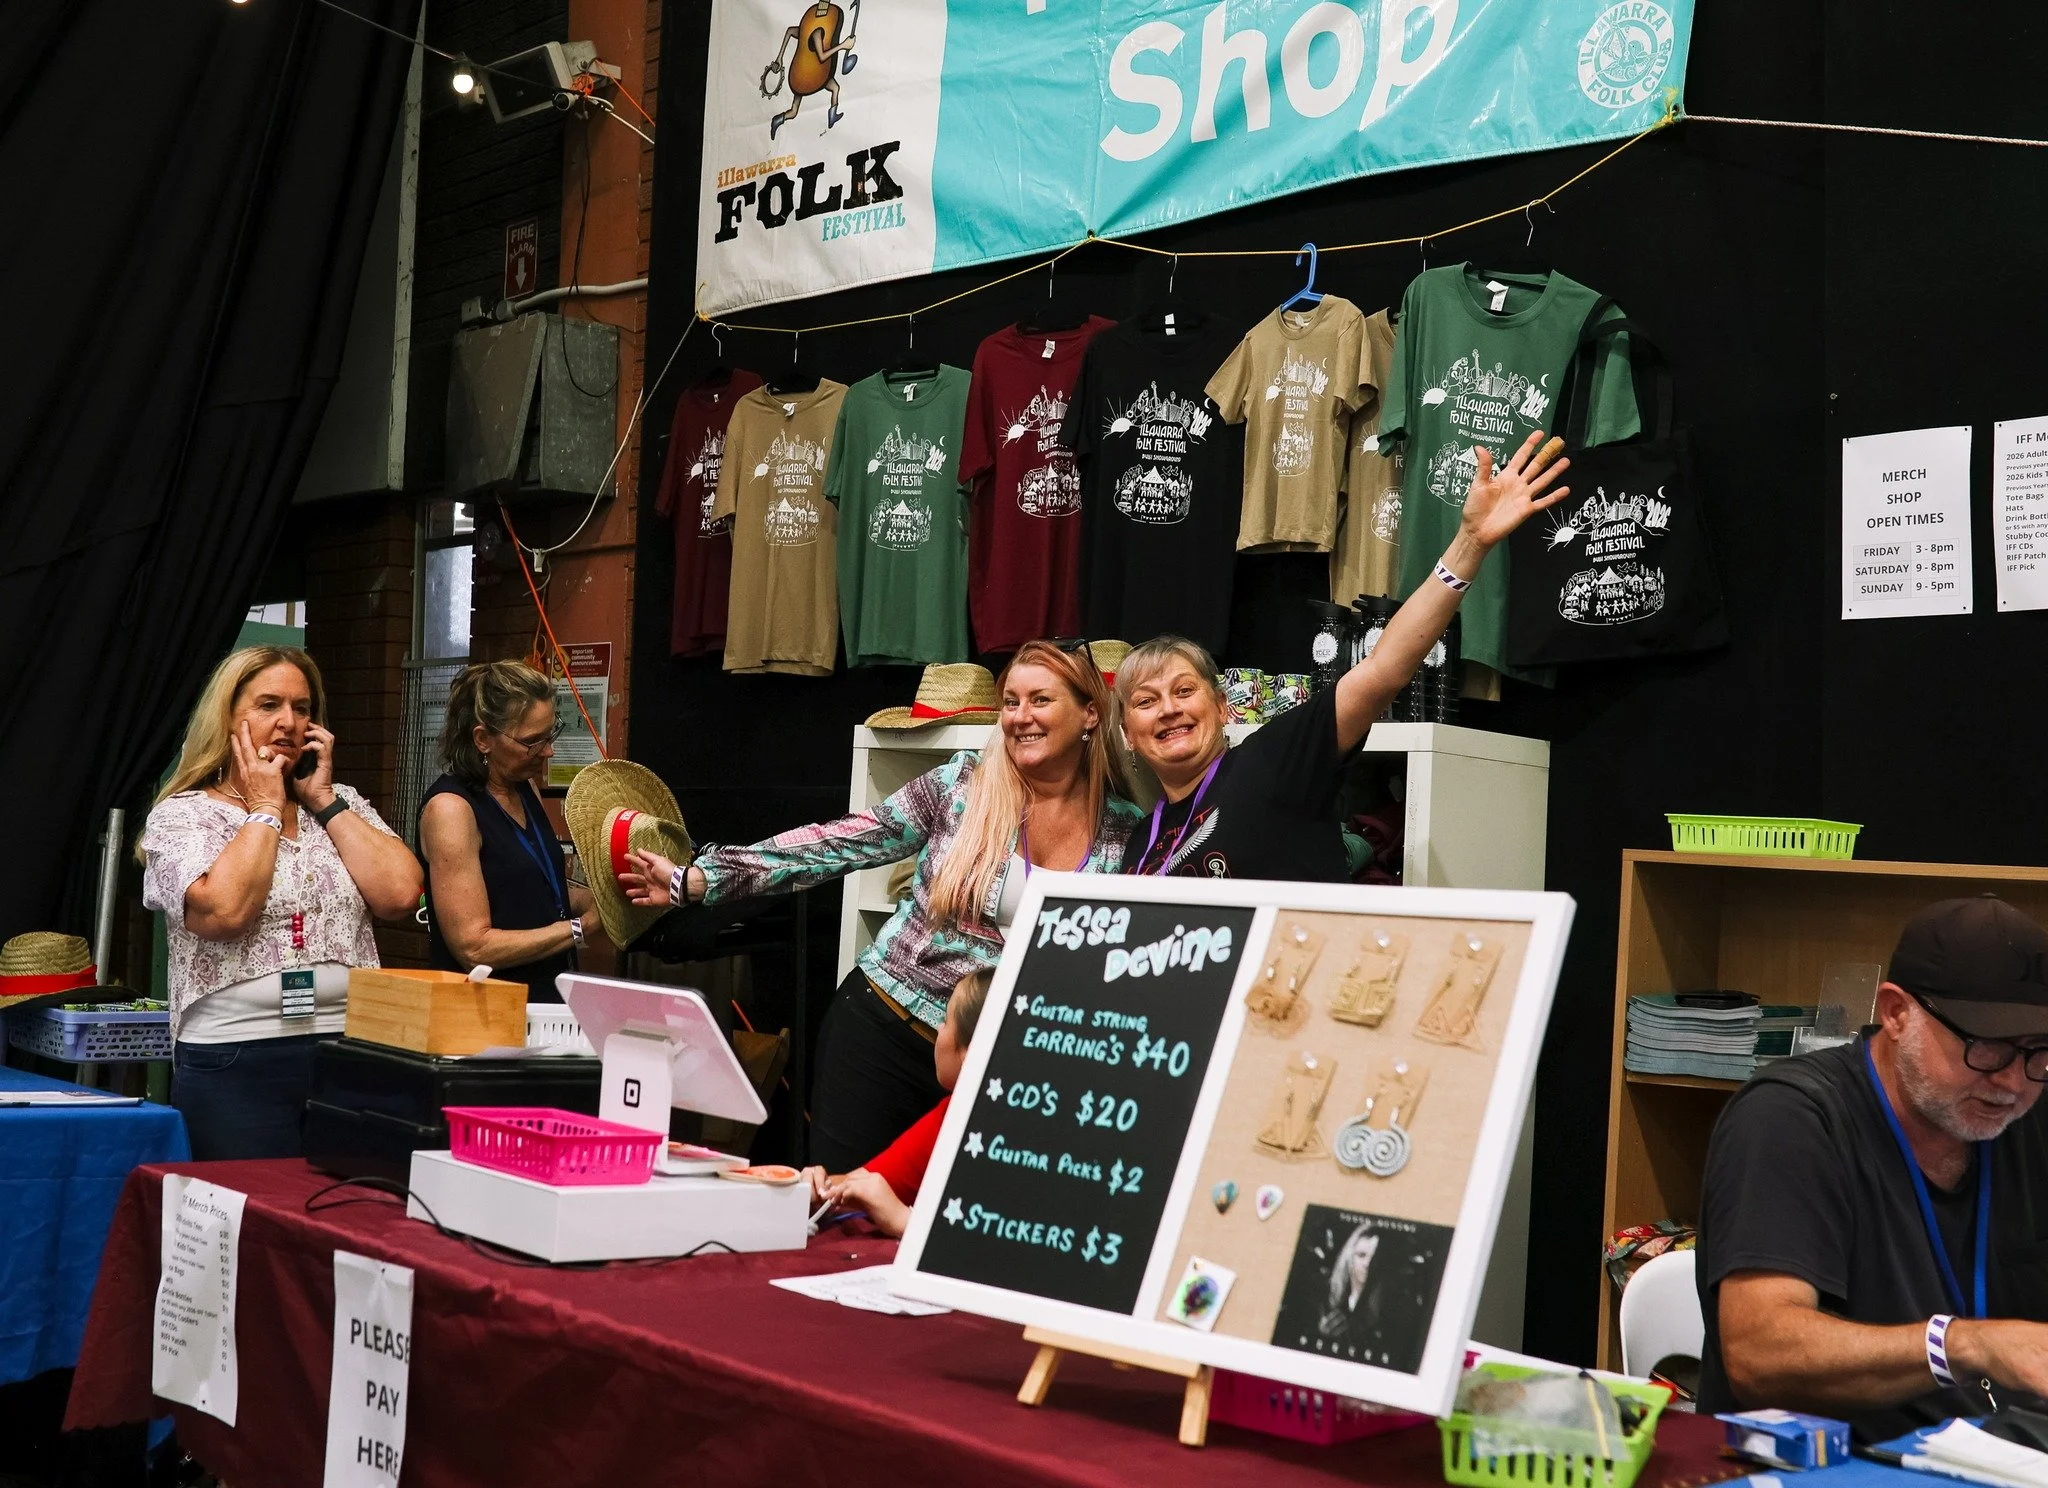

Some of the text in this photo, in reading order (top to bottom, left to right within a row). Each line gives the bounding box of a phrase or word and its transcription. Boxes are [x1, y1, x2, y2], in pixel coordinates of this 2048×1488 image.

[1580, 2, 1667, 66] ILLAWARRA
[1586, 37, 1672, 105] FOLK CLUB
[717, 153, 797, 188] illawarra
[714, 140, 904, 244] FOLK
[822, 202, 906, 241] FESTIVAL
[510, 223, 535, 244] FIRE
[509, 242, 535, 263] ALARM
[1455, 395, 1510, 417] ILLAWARRA
[1139, 423, 1184, 439] ILLAWARRA
[1449, 410, 1514, 435] FOLK FESTIVAL
[1153, 439, 1187, 453] FESTIVAL
[2016, 434, 2032, 444] IFF
[2006, 452, 2024, 460] 2026
[1882, 468, 1927, 482] MERCH
[2006, 473, 2024, 481] 2026
[2026, 471, 2043, 479] Kids
[1886, 491, 1922, 505] SHOP
[2026, 493, 2044, 501] Bags
[1867, 512, 1944, 529] OPEN TIMES
[2006, 514, 2027, 522] Drink
[1590, 521, 1636, 542] ILLAWARRA
[2006, 532, 2033, 540] Stubby
[1585, 535, 1645, 557] FOLK FESTIVAL
[1864, 546, 1900, 557] FRIDAY
[1915, 544, 1922, 553] 3
[1930, 543, 1954, 554] 8pm
[2025, 552, 2046, 560] Patch
[1855, 564, 1910, 576] SATURDAY
[1916, 563, 1922, 573] 9
[1930, 562, 1954, 573] 8pm
[1861, 583, 1904, 594] SUNDAY
[1916, 582, 1922, 591] 9
[1931, 581, 1955, 592] 5pm
[1091, 1010, 1148, 1033] STRING
[1022, 1026, 1190, 1077] EARRING'S $40
[1006, 1082, 1138, 1132] CD'S $20
[1108, 1158, 1144, 1196] $2
[963, 1203, 1123, 1265] STICKERS $3
[351, 1318, 410, 1364] PLEASE
[366, 1380, 400, 1417] PAY
[357, 1436, 399, 1480] HERE
